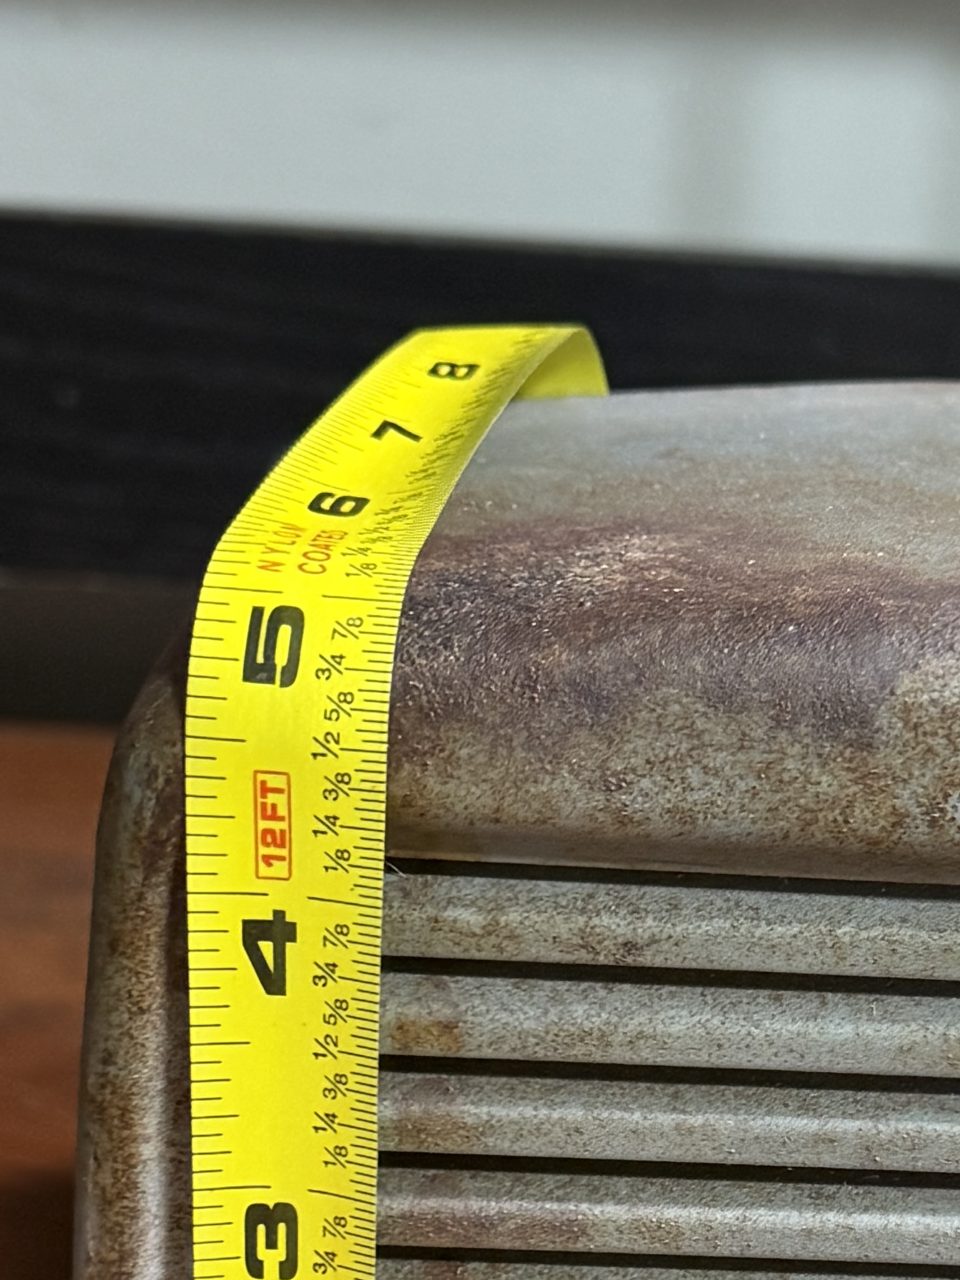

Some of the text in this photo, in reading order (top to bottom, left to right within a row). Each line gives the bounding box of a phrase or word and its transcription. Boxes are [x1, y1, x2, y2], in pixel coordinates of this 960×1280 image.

[428, 362, 480, 380] 8
[371, 420, 422, 444] 7
[307, 492, 370, 517] 6
[256, 522, 307, 573] NYLON
[331, 616, 365, 641] 7/8
[242, 604, 305, 689] 5
[315, 653, 346, 681] 3/4
[323, 691, 355, 722] 5/8
[311, 731, 341, 760] 1/2
[322, 772, 352, 801] 3/8
[312, 814, 340, 838] 1/4
[323, 848, 352, 874] 1/8
[322, 923, 350, 949] 7/8
[241, 909, 297, 997] 4
[312, 961, 339, 988] 3/4
[323, 998, 349, 1026] 5/8
[312, 1034, 339, 1060] 1/2
[322, 1073, 349, 1100] 3/8
[312, 1111, 339, 1134] 1/4
[322, 1145, 349, 1169] 1/8
[322, 1215, 348, 1240] 7/8
[244, 1202, 298, 1280] 3
[312, 1250, 338, 1275] 3/4
